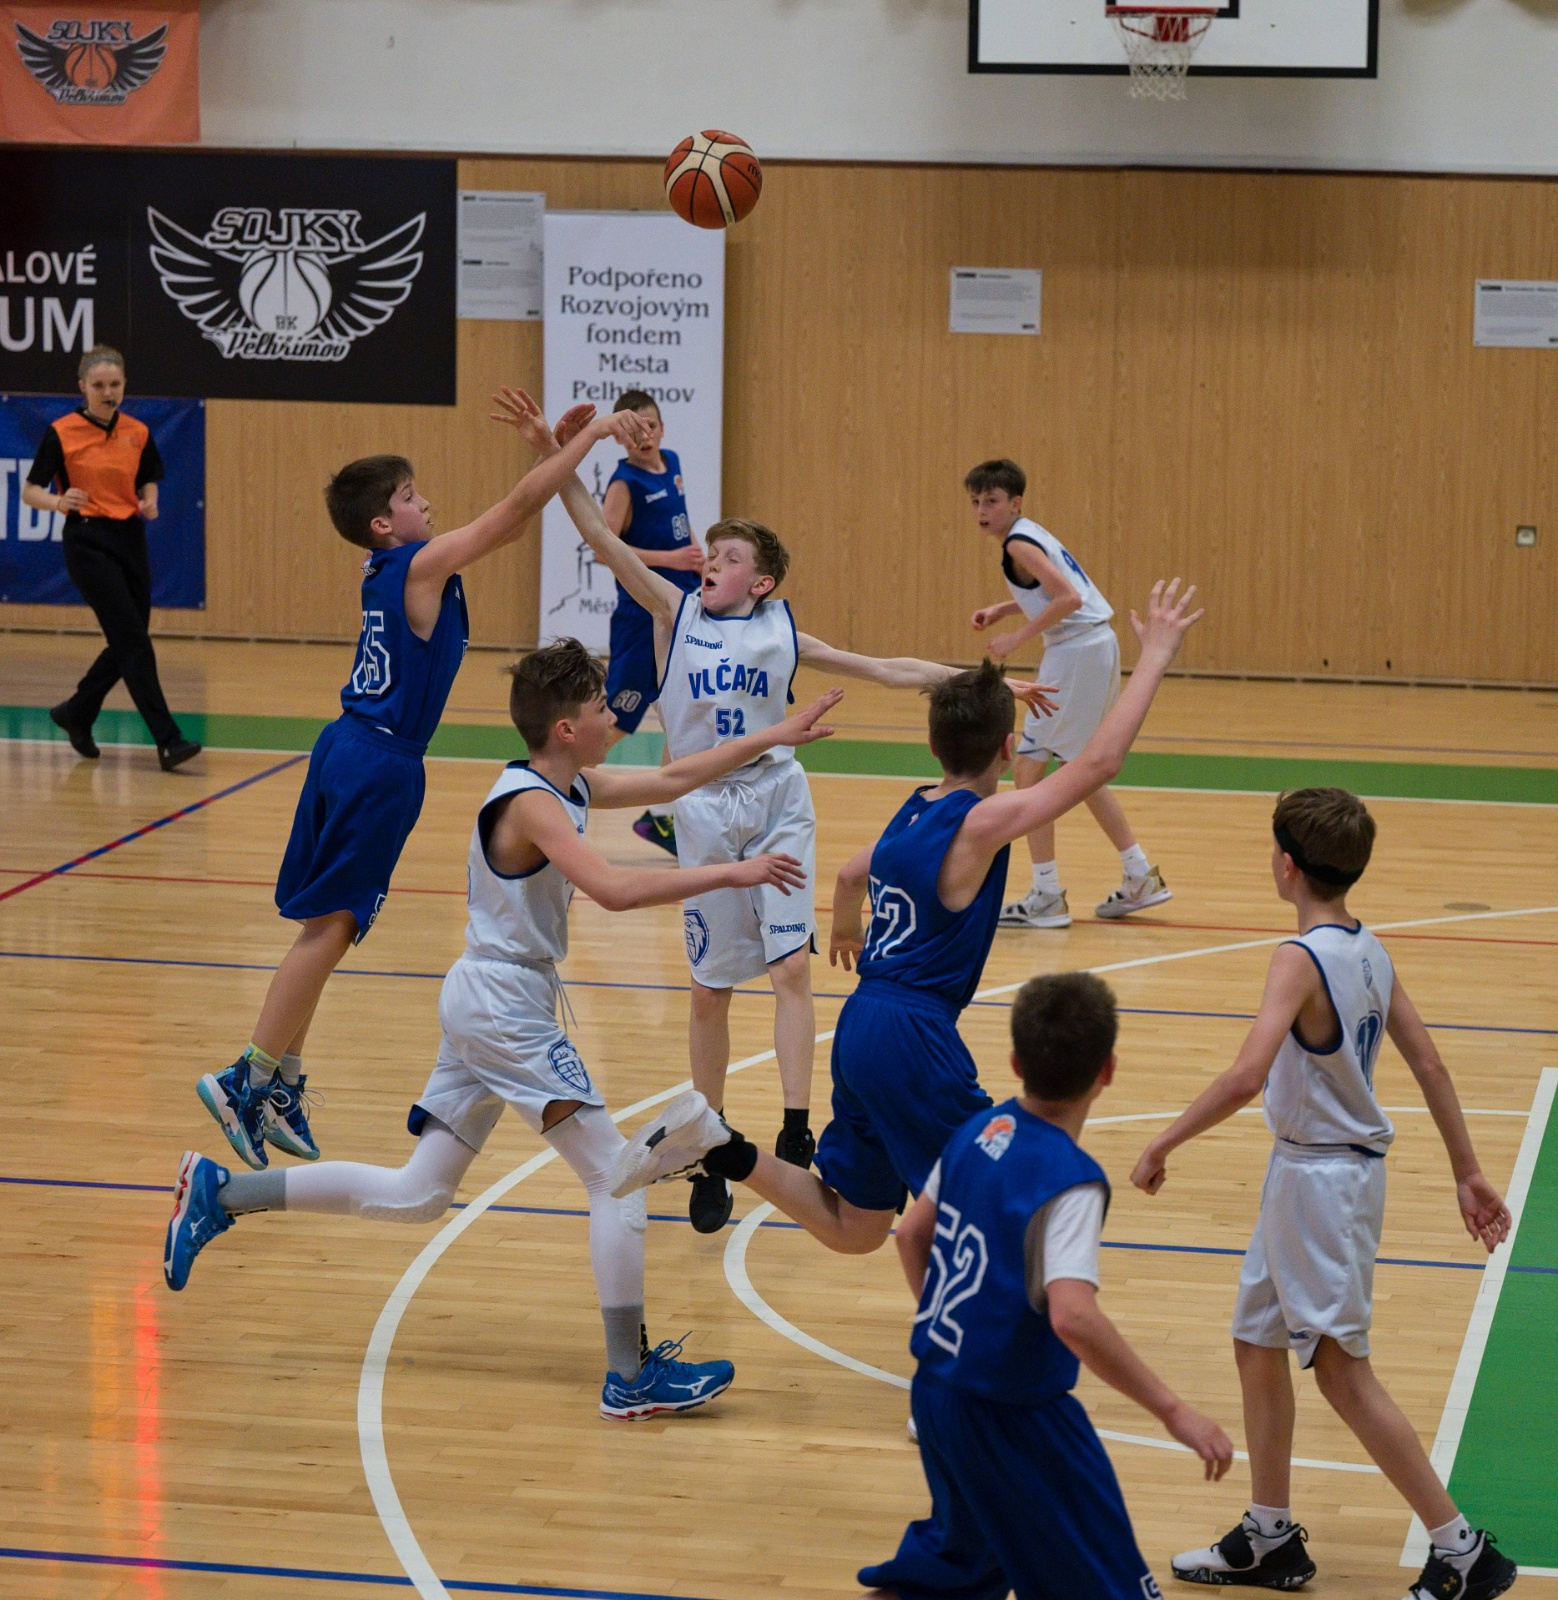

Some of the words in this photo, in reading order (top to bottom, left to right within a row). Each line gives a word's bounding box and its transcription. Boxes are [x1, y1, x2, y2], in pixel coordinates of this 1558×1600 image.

[47, 20, 135, 42] SOJKY
[205, 208, 365, 251] SOJKY
[0, 244, 97, 285] LOVÉ
[568, 265, 703, 292] Podpořeno
[560, 294, 710, 322] Rozvojovým
[274, 314, 298, 331] BK
[586, 322, 681, 345] fondem
[226, 330, 348, 358] Pelhřimov
[598, 352, 669, 374] Města
[684, 634, 723, 650] SPALDING
[688, 657, 769, 699] VLČATA
[715, 707, 746, 737] 52
[769, 922, 806, 935] SPALDING
